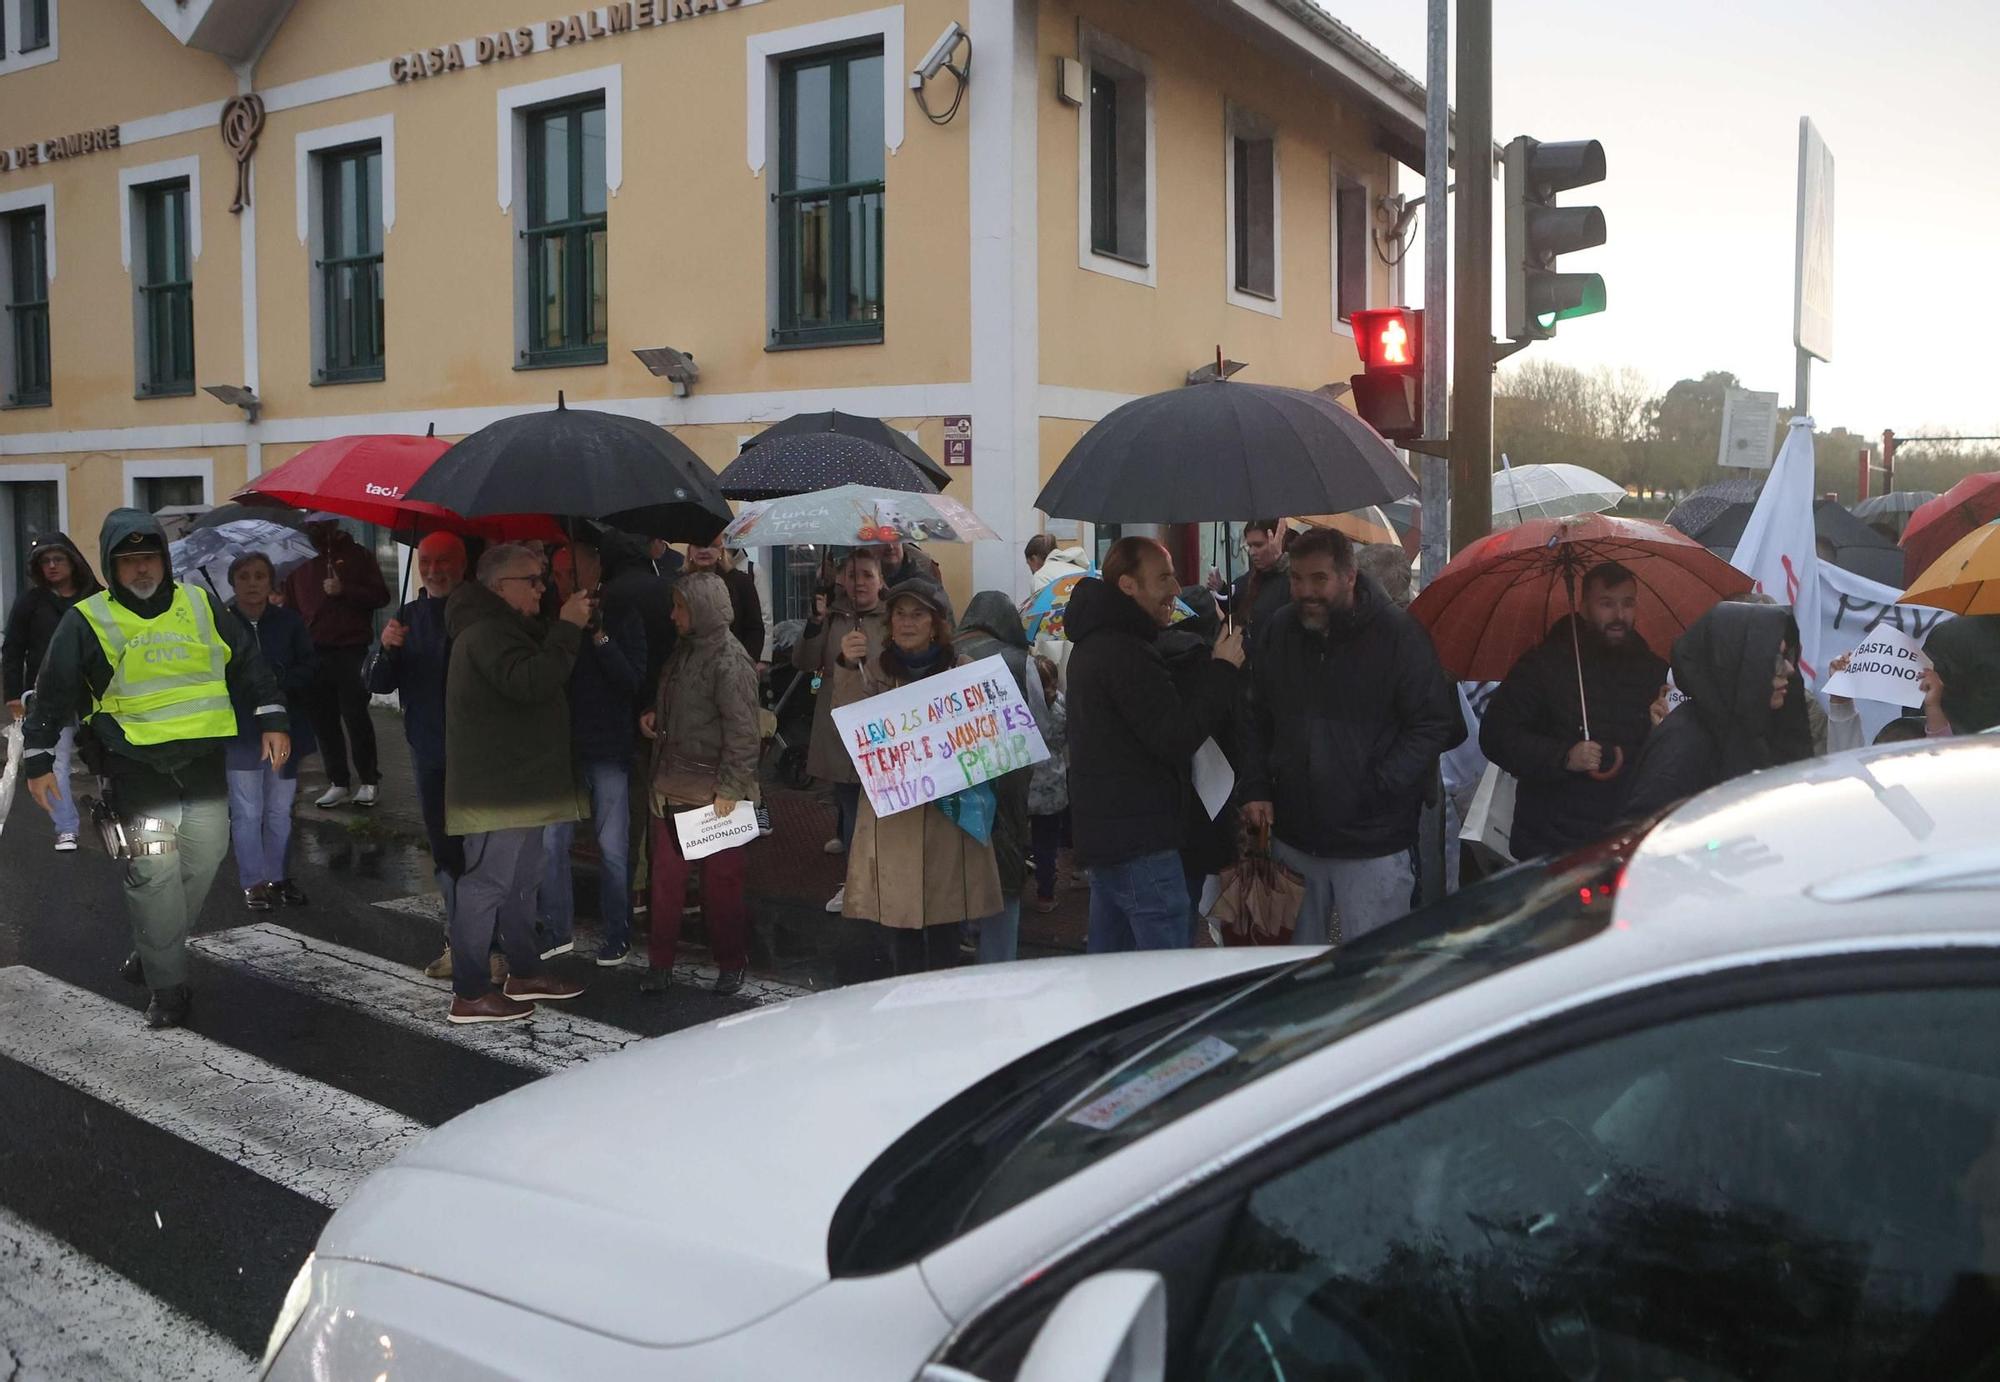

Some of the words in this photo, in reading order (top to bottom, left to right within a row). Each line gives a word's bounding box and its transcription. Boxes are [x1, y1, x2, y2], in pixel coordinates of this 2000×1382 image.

[390, 43, 465, 82] CASA
[476, 27, 533, 63] DAS
[547, 0, 742, 48] PALMEIR
[16, 143, 38, 169] DE
[46, 125, 120, 160] CAMBRE
[144, 645, 190, 663] CIVIL
[1897, 648, 1919, 662] DE
[855, 718, 896, 748] LLEVO
[901, 709, 922, 732] 25
[928, 692, 963, 723] AÑOS
[858, 736, 933, 776] TEMPLE
[947, 713, 999, 753] NUNCA
[878, 775, 935, 811] TUVO
[686, 824, 754, 849] ABANDONADOS
[701, 819, 733, 834] COLEGIOS
